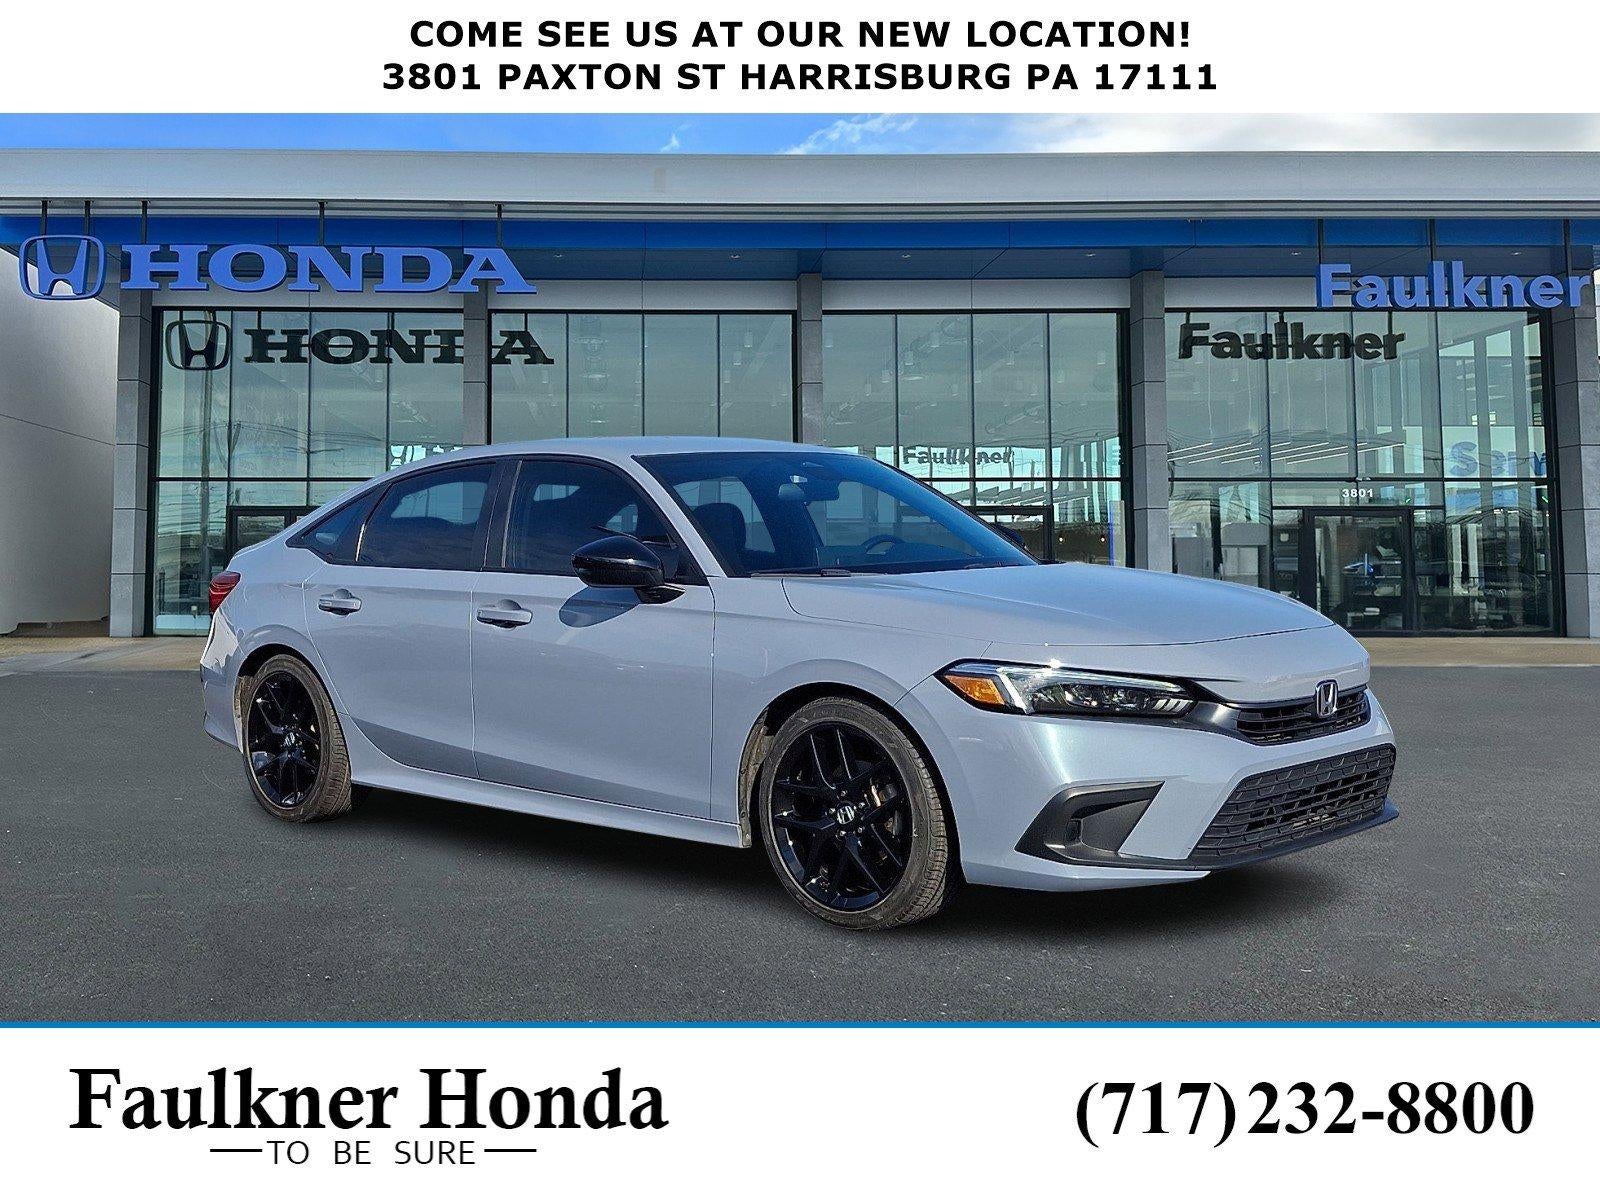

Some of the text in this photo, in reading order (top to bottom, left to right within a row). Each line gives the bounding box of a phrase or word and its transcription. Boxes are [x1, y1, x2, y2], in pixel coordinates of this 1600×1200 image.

[120, 244, 537, 294] HONDA
[1317, 260, 1591, 310] Faulkner
[1178, 322, 1405, 360] Faulkner
[1342, 487, 1374, 498] 3801
